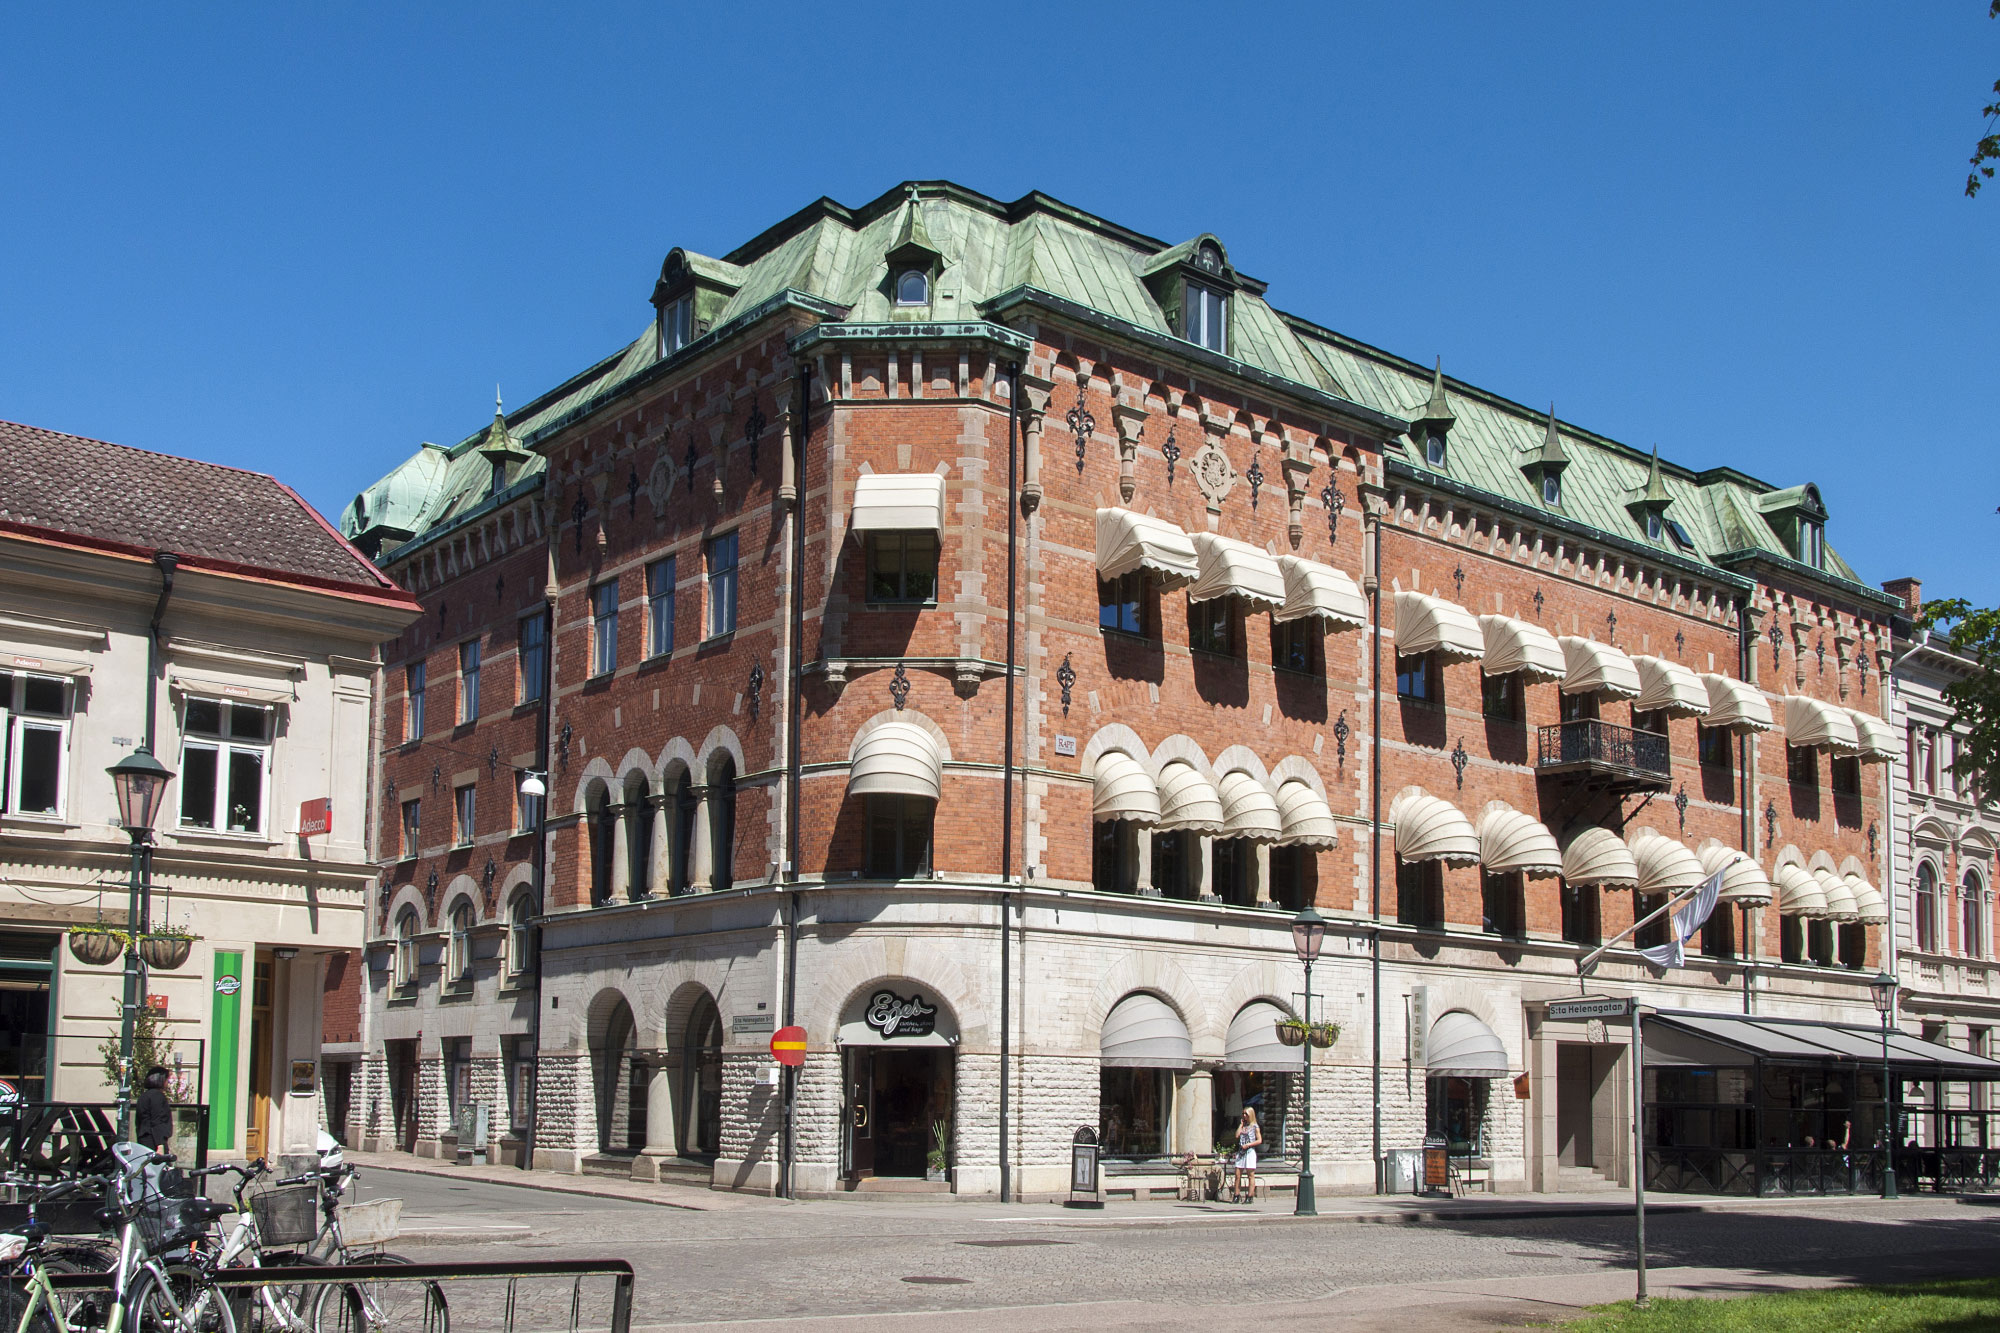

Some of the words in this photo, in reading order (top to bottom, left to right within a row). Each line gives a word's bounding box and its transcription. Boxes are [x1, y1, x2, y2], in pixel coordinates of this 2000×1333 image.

[301, 818, 326, 833] Adecco
[867, 993, 934, 1035] Ejes
[1550, 1006, 1567, 1015] S:ta
[1568, 1003, 1623, 1014] Helenagatan
